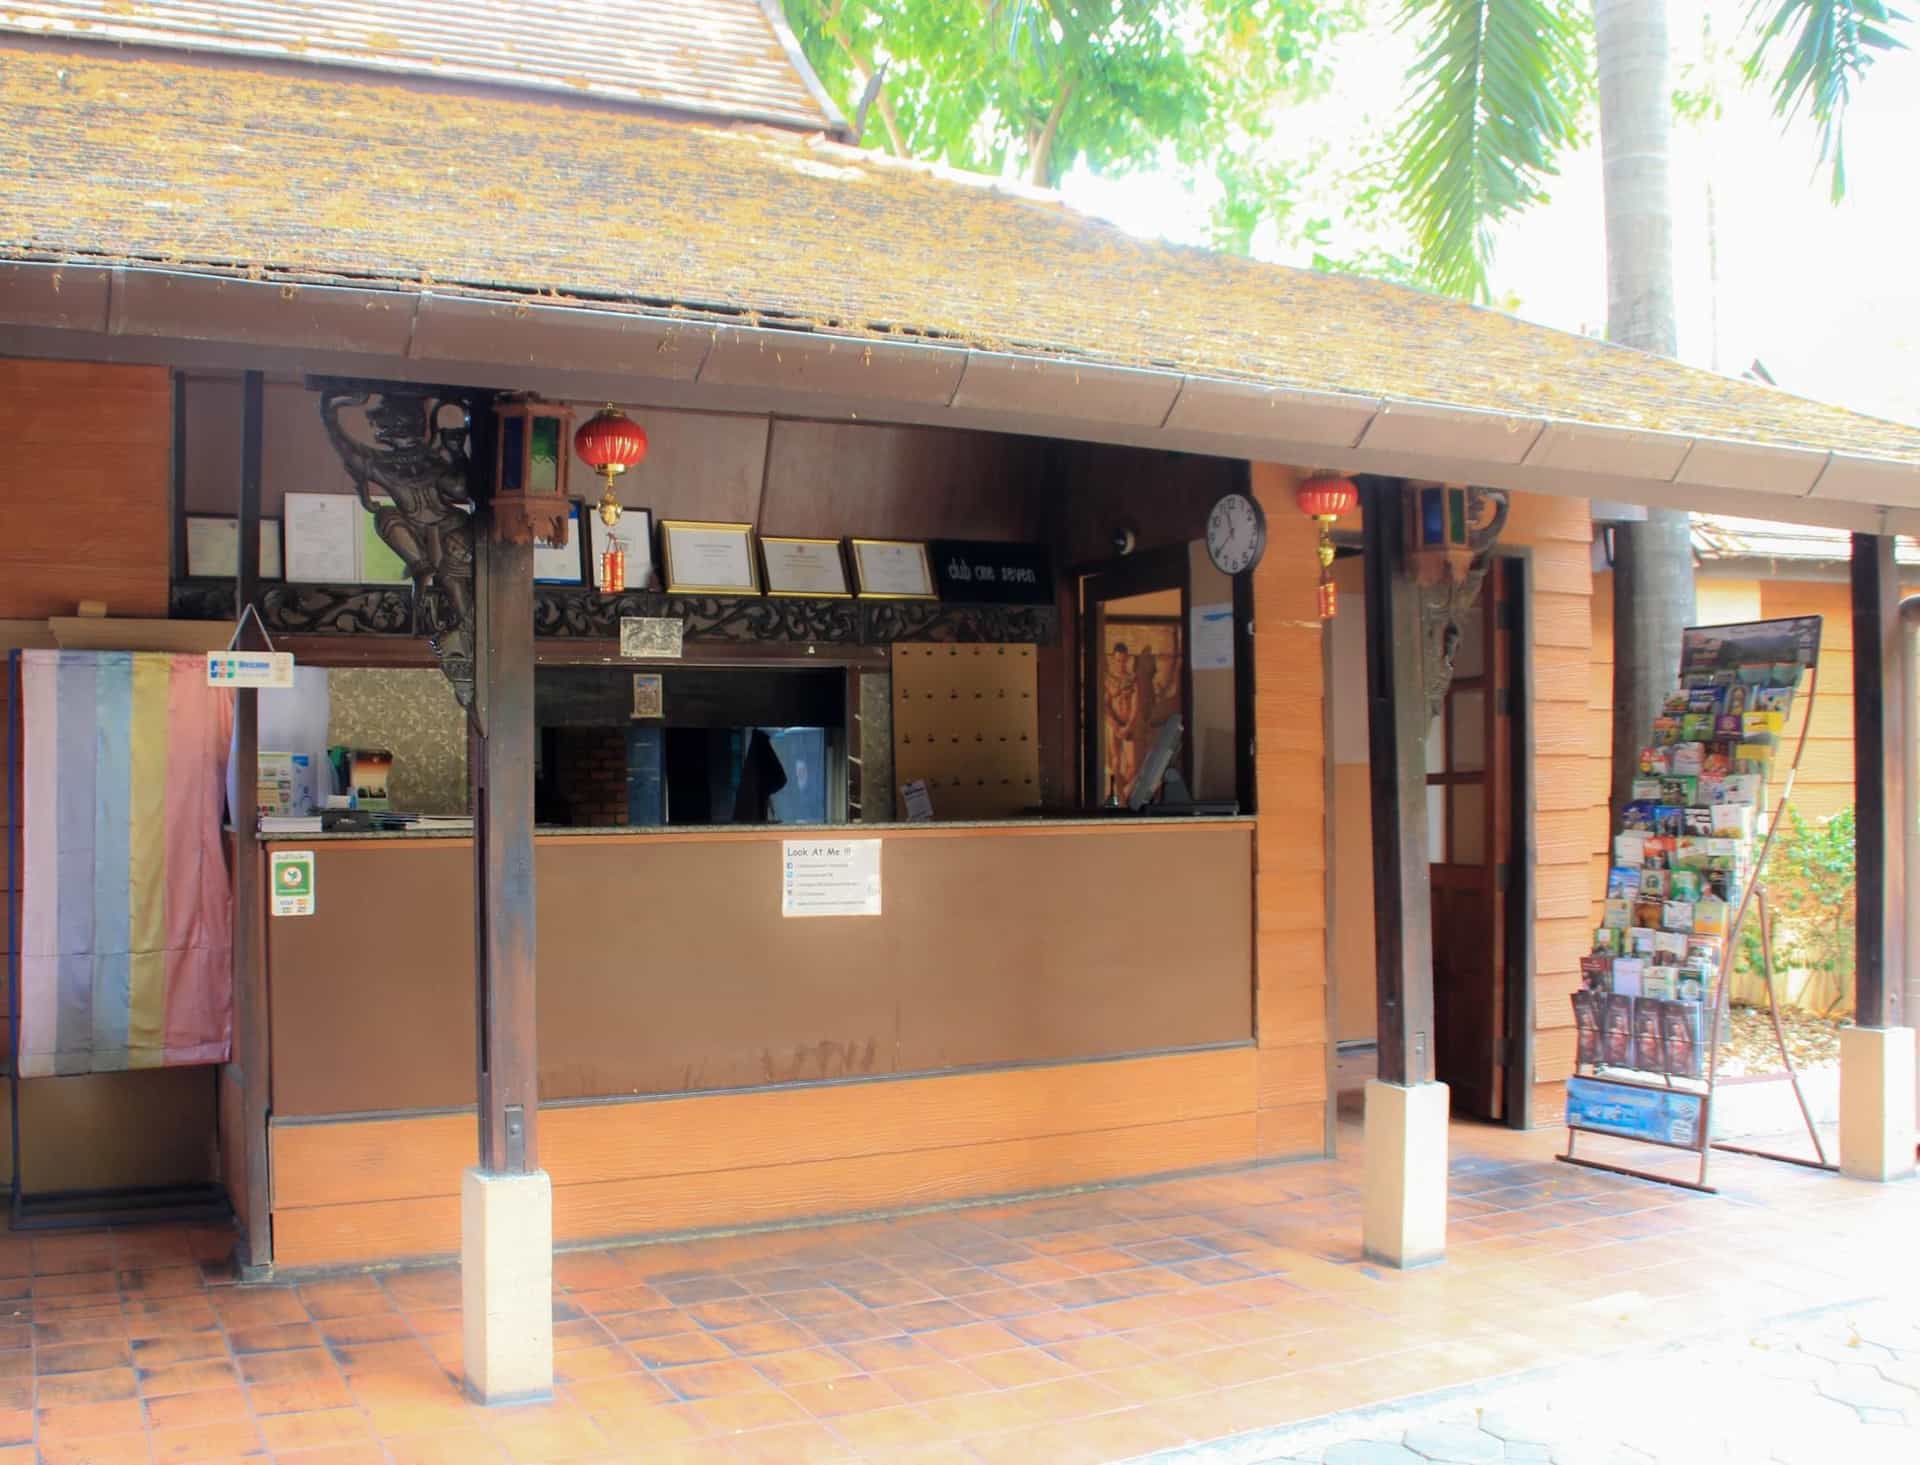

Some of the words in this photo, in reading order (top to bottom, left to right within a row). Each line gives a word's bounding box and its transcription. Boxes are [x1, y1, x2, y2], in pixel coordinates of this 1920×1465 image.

[787, 847, 808, 857] Look
[812, 848, 823, 857] At
[827, 848, 840, 856] Me
